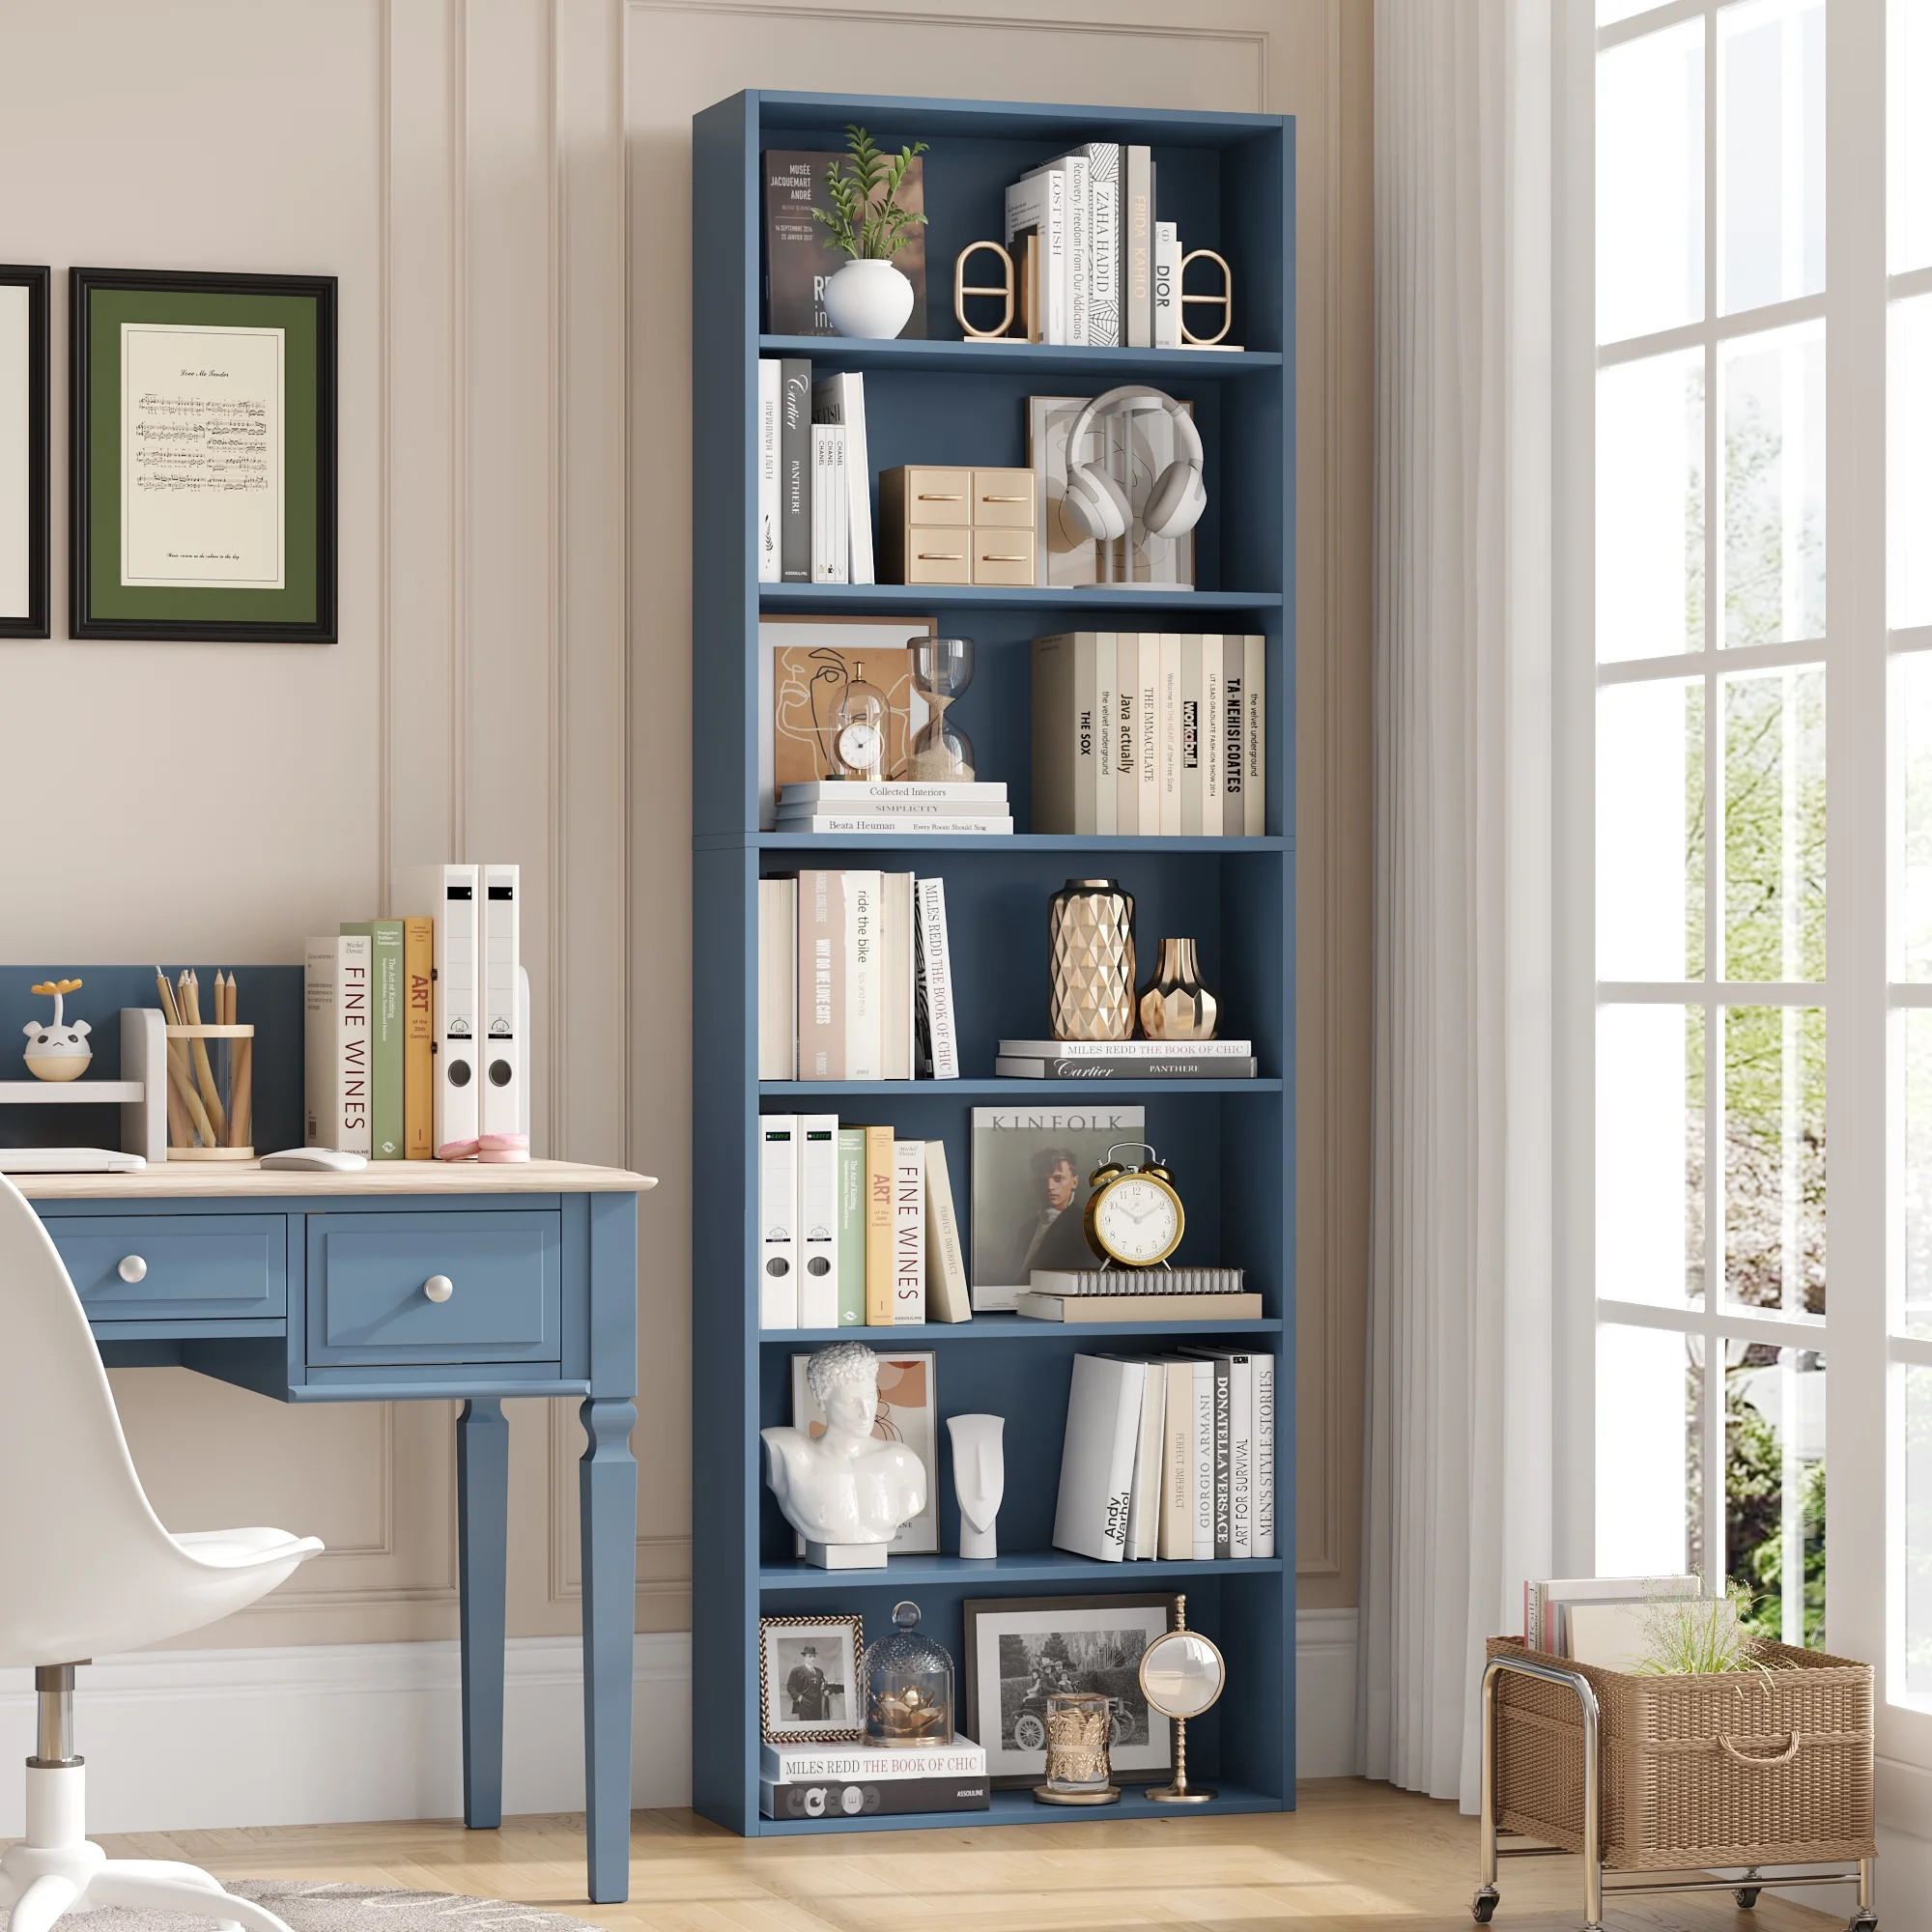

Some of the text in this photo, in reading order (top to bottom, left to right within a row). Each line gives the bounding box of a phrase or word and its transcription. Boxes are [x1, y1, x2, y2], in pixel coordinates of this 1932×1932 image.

[771, 176, 811, 187] JACQUEMART
[789, 163, 811, 175] MUSÉE
[790, 189, 811, 200] ANDRÉ
[1053, 175, 1062, 256] LOST FISH
[1069, 163, 1084, 339] Recovery. Freedom From Our Addictions
[1096, 192, 1109, 292] ZAHA HADID
[1134, 196, 1146, 298] FRIDA KAHLO
[1157, 266, 1170, 307] DIOR
[209, 369, 229, 378] Tender
[786, 374, 809, 430] Cartier
[1081, 711, 1091, 755] THE SOX
[1100, 728, 1110, 775] underground
[1117, 695, 1134, 774] Java actually
[1145, 688, 1153, 782] THE IMMACULATE
[1228, 679, 1240, 793] TA-NEHISI COATES
[1249, 729, 1258, 777] underground
[869, 787, 947, 796] Collected Interiors
[829, 821, 895, 830] Beata Heuman
[925, 885, 939, 922] MILES
[858, 891, 868, 963] ride the bike
[928, 923, 943, 956] REDD
[816, 939, 831, 1024] WHY DO WE LOVE CATS
[931, 959, 945, 983] THE
[345, 968, 365, 1026] FINE
[386, 992, 396, 1018] Knitting
[412, 975, 429, 1012] ART
[933, 987, 948, 1019] BOOK
[936, 1022, 949, 1038] OF
[938, 1042, 952, 1070] CHIC
[1053, 1059, 1114, 1077] Cartier
[1067, 1046, 1103, 1055] MILES
[1216, 1045, 1243, 1054] CHIC
[345, 1039, 365, 1128] WINES
[991, 1116, 1124, 1132] KINFOLK
[873, 1174, 890, 1205] ART
[1121, 1190, 1126, 1200] 11
[1132, 1186, 1141, 1196] 12
[1150, 1190, 1153, 1199] 1
[898, 1168, 918, 1299] FINE WINES
[1105, 1216, 1111, 1225] 9
[1165, 1215, 1171, 1225] 3
[940, 1207, 957, 1275] PERFECT IMPERFECT
[1121, 1240, 1126, 1250] 7
[1151, 1240, 1157, 1250] 5
[1175, 1433, 1184, 1509] PERFECT IMPERFECT
[1200, 1394, 1209, 1528] GIORGIO ARMANI
[1217, 1377, 1228, 1544] DONATELLA VERSACE
[1260, 1371, 1273, 1538] MEN'S STYLE STORIES
[1236, 1439, 1248, 1546] ART FOR SURVIVAL
[1105, 1497, 1121, 1538] Andy
[1116, 1492, 1130, 1546] Warhol
[785, 1761, 824, 1776] MILES
[827, 1760, 860, 1774] REDD
[864, 1759, 889, 1774] THE
[893, 1758, 925, 1772] BOOK
[928, 1758, 945, 1771] OF
[948, 1757, 977, 1771] CHIC
[956, 1789, 983, 1798] ASSOULINE
